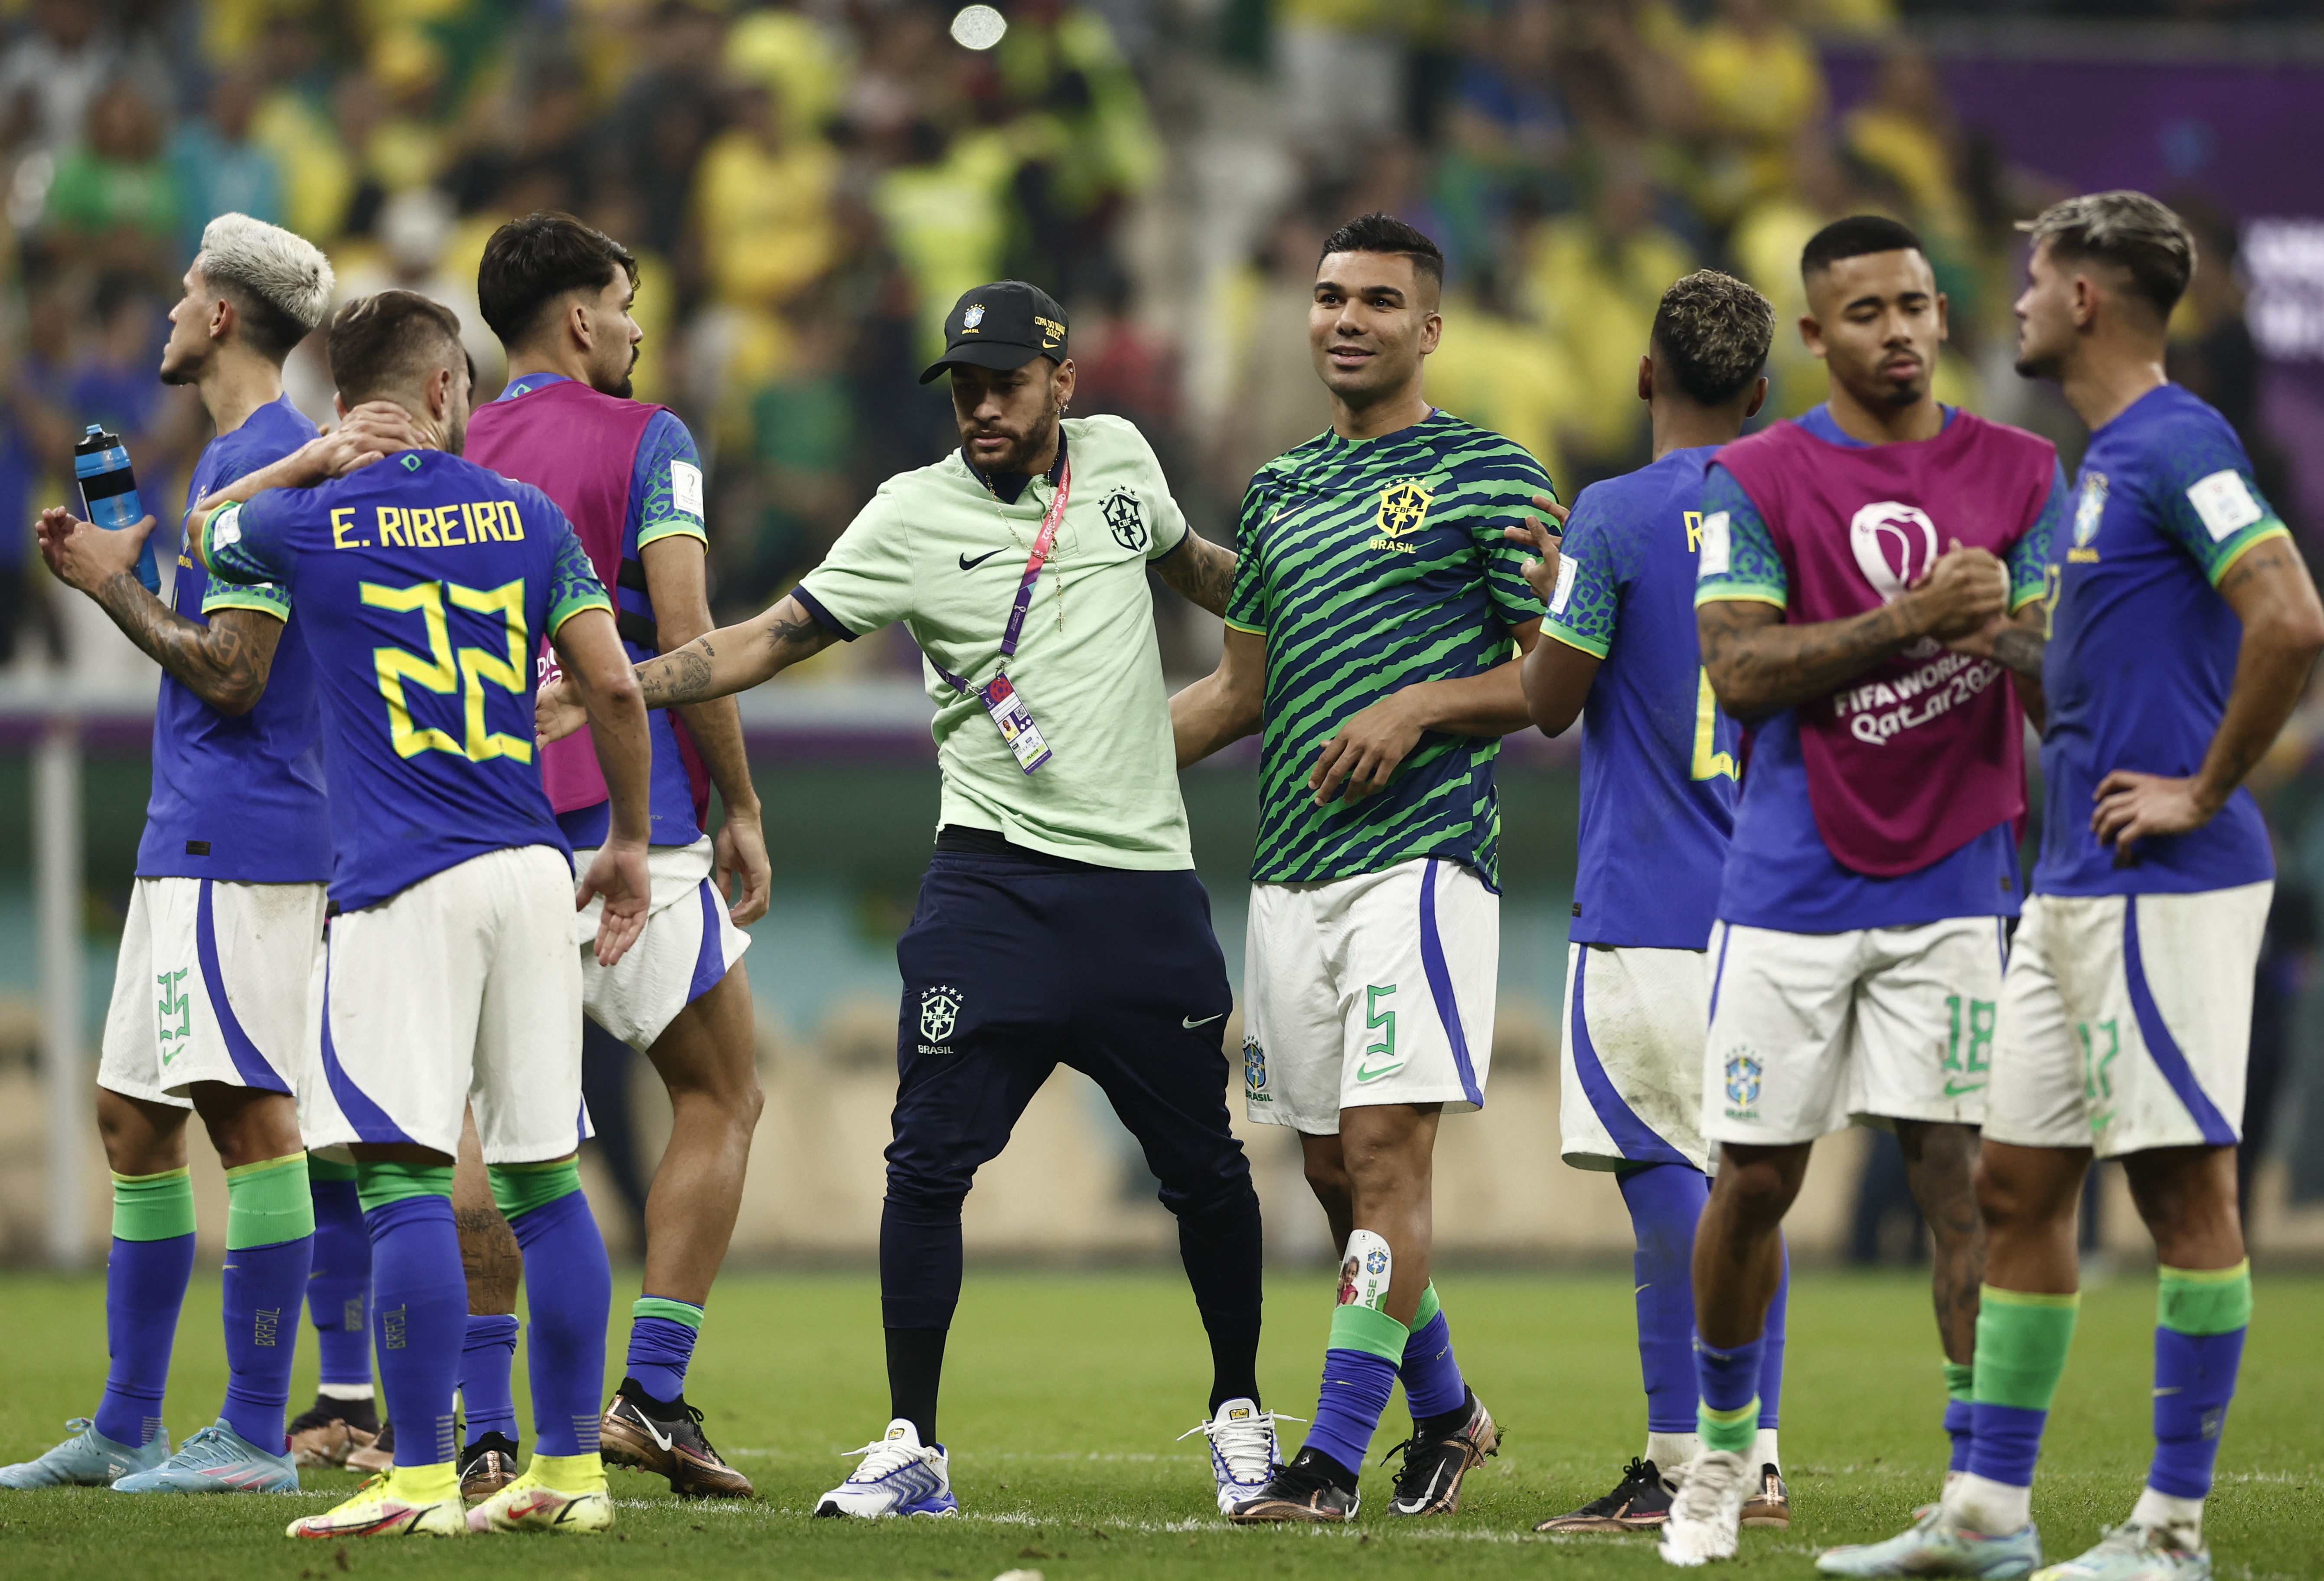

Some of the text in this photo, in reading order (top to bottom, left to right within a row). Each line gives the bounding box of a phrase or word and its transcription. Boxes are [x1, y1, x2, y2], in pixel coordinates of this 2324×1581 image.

[1035, 316, 1048, 327] COPA
[1047, 319, 1055, 329] DO
[1045, 327, 1061, 341] 2022
[330, 500, 526, 549] E. RIBEIRO
[1118, 518, 1131, 528] CBF
[1369, 539, 1417, 554] BRASIL
[359, 578, 533, 766] 22
[1834, 683, 1898, 718] FIFA
[1850, 658, 2002, 746] Qatar202
[1025, 748, 1040, 760] PLAYER
[1366, 984, 1397, 1056] 5
[1942, 994, 1997, 1073] 18
[917, 1045, 954, 1055] BRASIL
[1245, 1088, 1273, 1102] BRASIL
[1364, 1279, 1378, 1309] ASE
[255, 1307, 281, 1347] BRASIL
[382, 1303, 407, 1350] BRASIL
